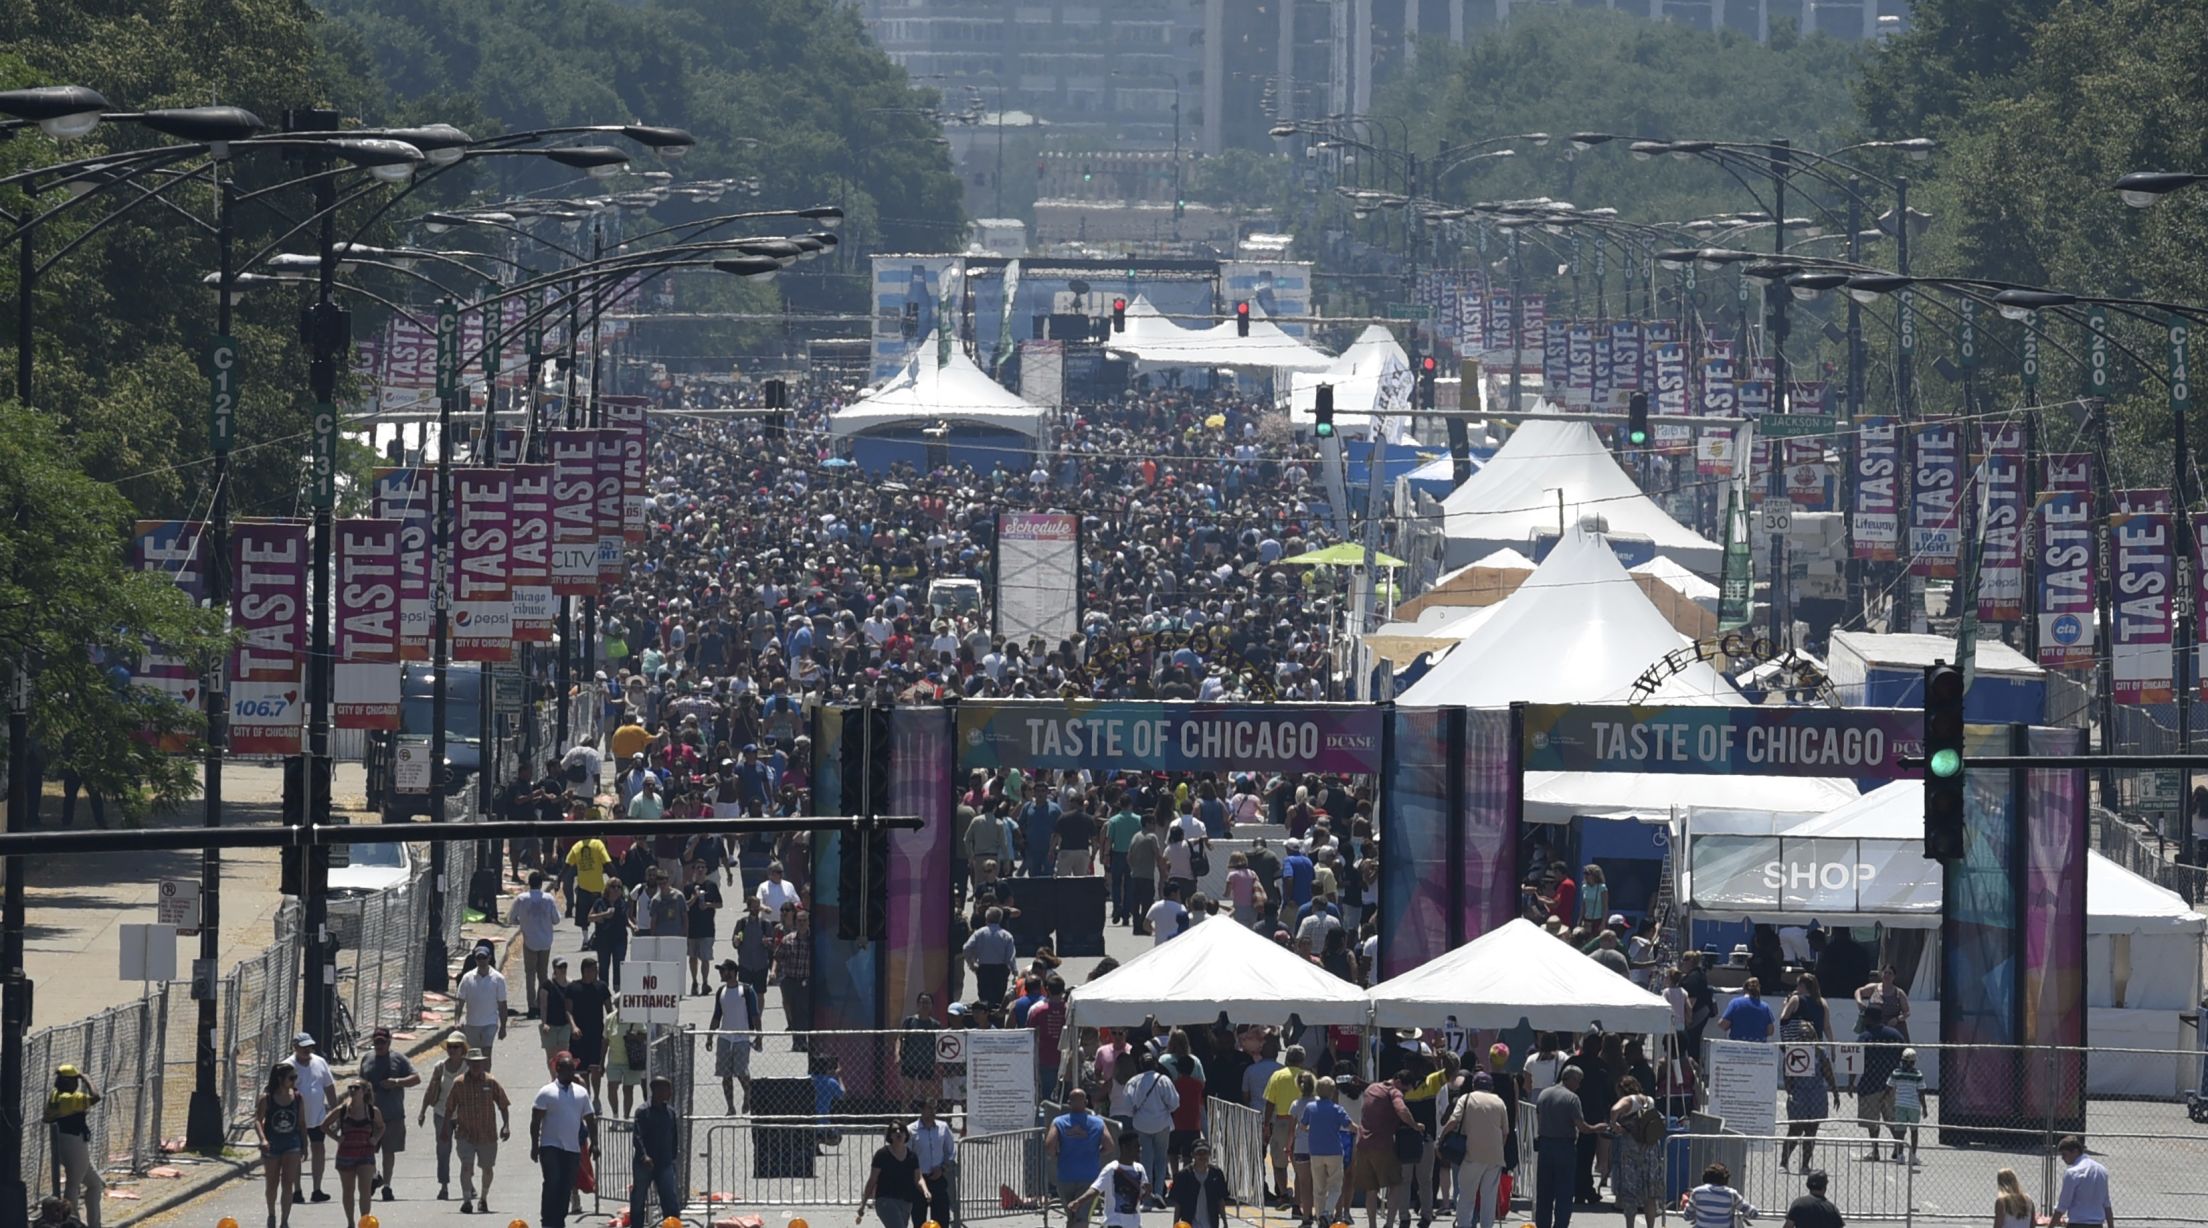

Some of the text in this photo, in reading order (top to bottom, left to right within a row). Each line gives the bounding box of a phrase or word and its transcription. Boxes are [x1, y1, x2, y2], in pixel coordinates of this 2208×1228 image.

[1491, 300, 1512, 349] TASTE
[1522, 300, 1544, 349] TASTE
[388, 318, 420, 385] TASTE
[439, 313, 456, 388] C141
[1569, 330, 1592, 386] TASTE
[1612, 325, 1638, 387] TASTE
[2089, 316, 2106, 386] C200
[2169, 326, 2188, 400] C140
[213, 347, 233, 437] C121
[1771, 417, 1820, 427] JACKSON
[314, 413, 334, 496] C131
[1860, 424, 1896, 512] TASTE
[552, 441, 594, 542] TASTE
[1916, 432, 1955, 525] TASTE
[460, 481, 507, 598] TASTE
[1004, 516, 1071, 535] Schedule
[1766, 515, 1788, 529] 30
[1855, 518, 1896, 533] Lifeway
[551, 550, 596, 569] CLTV
[2044, 502, 2089, 611] TASTE
[343, 533, 395, 661] TASTE
[2119, 525, 2166, 642] TASTE
[240, 537, 297, 678] TASTE
[474, 612, 509, 626] pepsi
[2056, 623, 2077, 635] cta
[2116, 681, 2171, 691] CITY OF CHICAGO
[234, 701, 287, 717] 106.7
[337, 705, 398, 715] CITY OF CHICAGO
[233, 727, 299, 738] CITY OF CHICAGO
[1026, 719, 1319, 759] TASTE OF CHICAGO
[1326, 736, 1376, 747] DCASE
[1591, 722, 1884, 766] TASTE OF CHICAGO
[1893, 742, 1924, 753] DCA
[1762, 862, 1876, 889] SHOP
[622, 994, 677, 1009] ENTRANCE
[642, 975, 658, 990] NO
[1445, 1031, 1464, 1051] 17
[1840, 1046, 1861, 1054] GATE
[1846, 1055, 1853, 1071] 1
